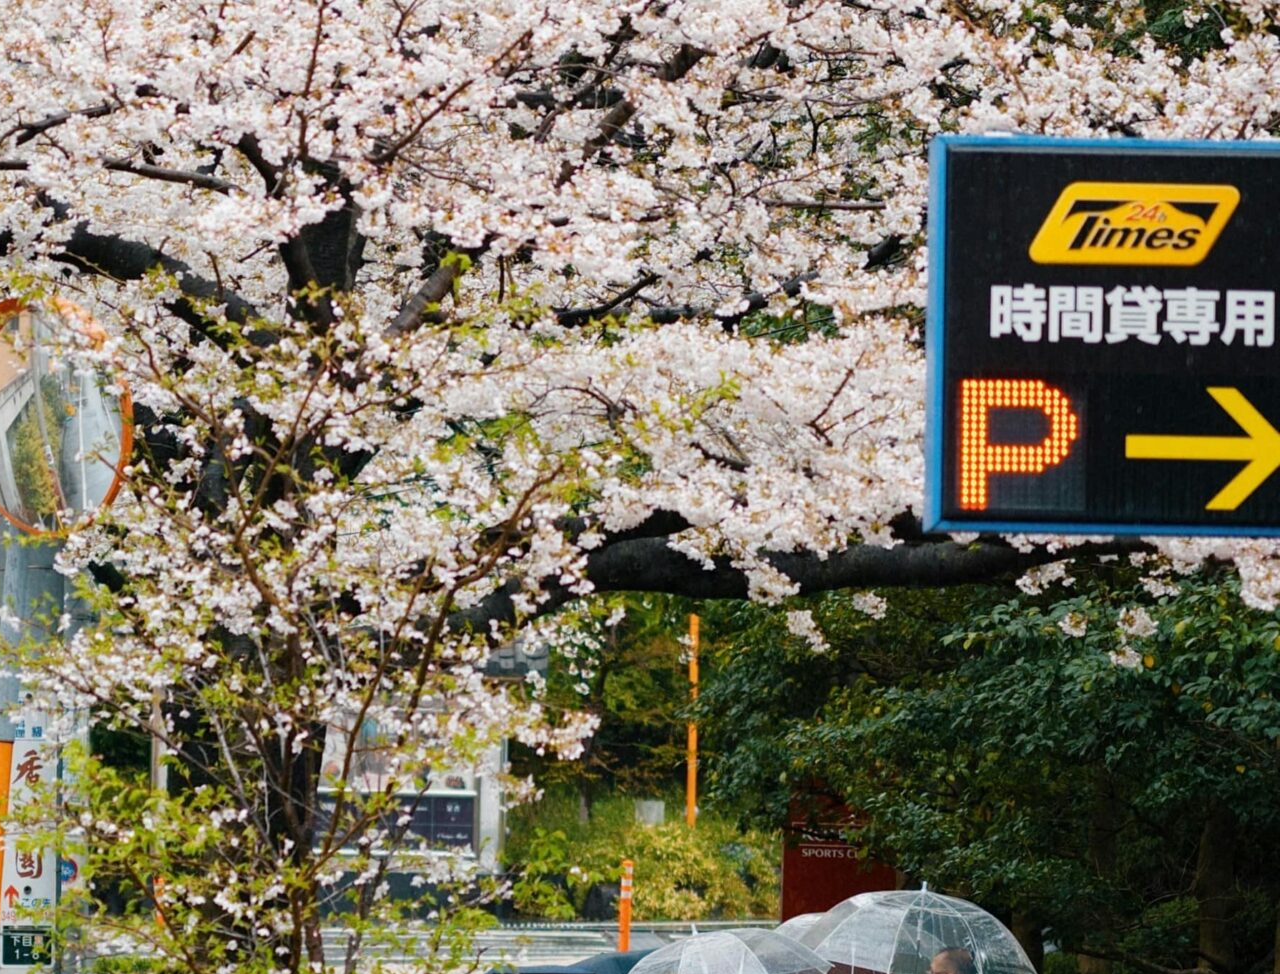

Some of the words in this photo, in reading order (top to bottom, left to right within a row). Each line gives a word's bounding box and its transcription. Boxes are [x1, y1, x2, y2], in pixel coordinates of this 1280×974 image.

[1069, 215, 1202, 251] Times
[989, 283, 1277, 348] 時間貸専用
[958, 378, 1079, 512] P
[801, 848, 844, 859] SPORTS
